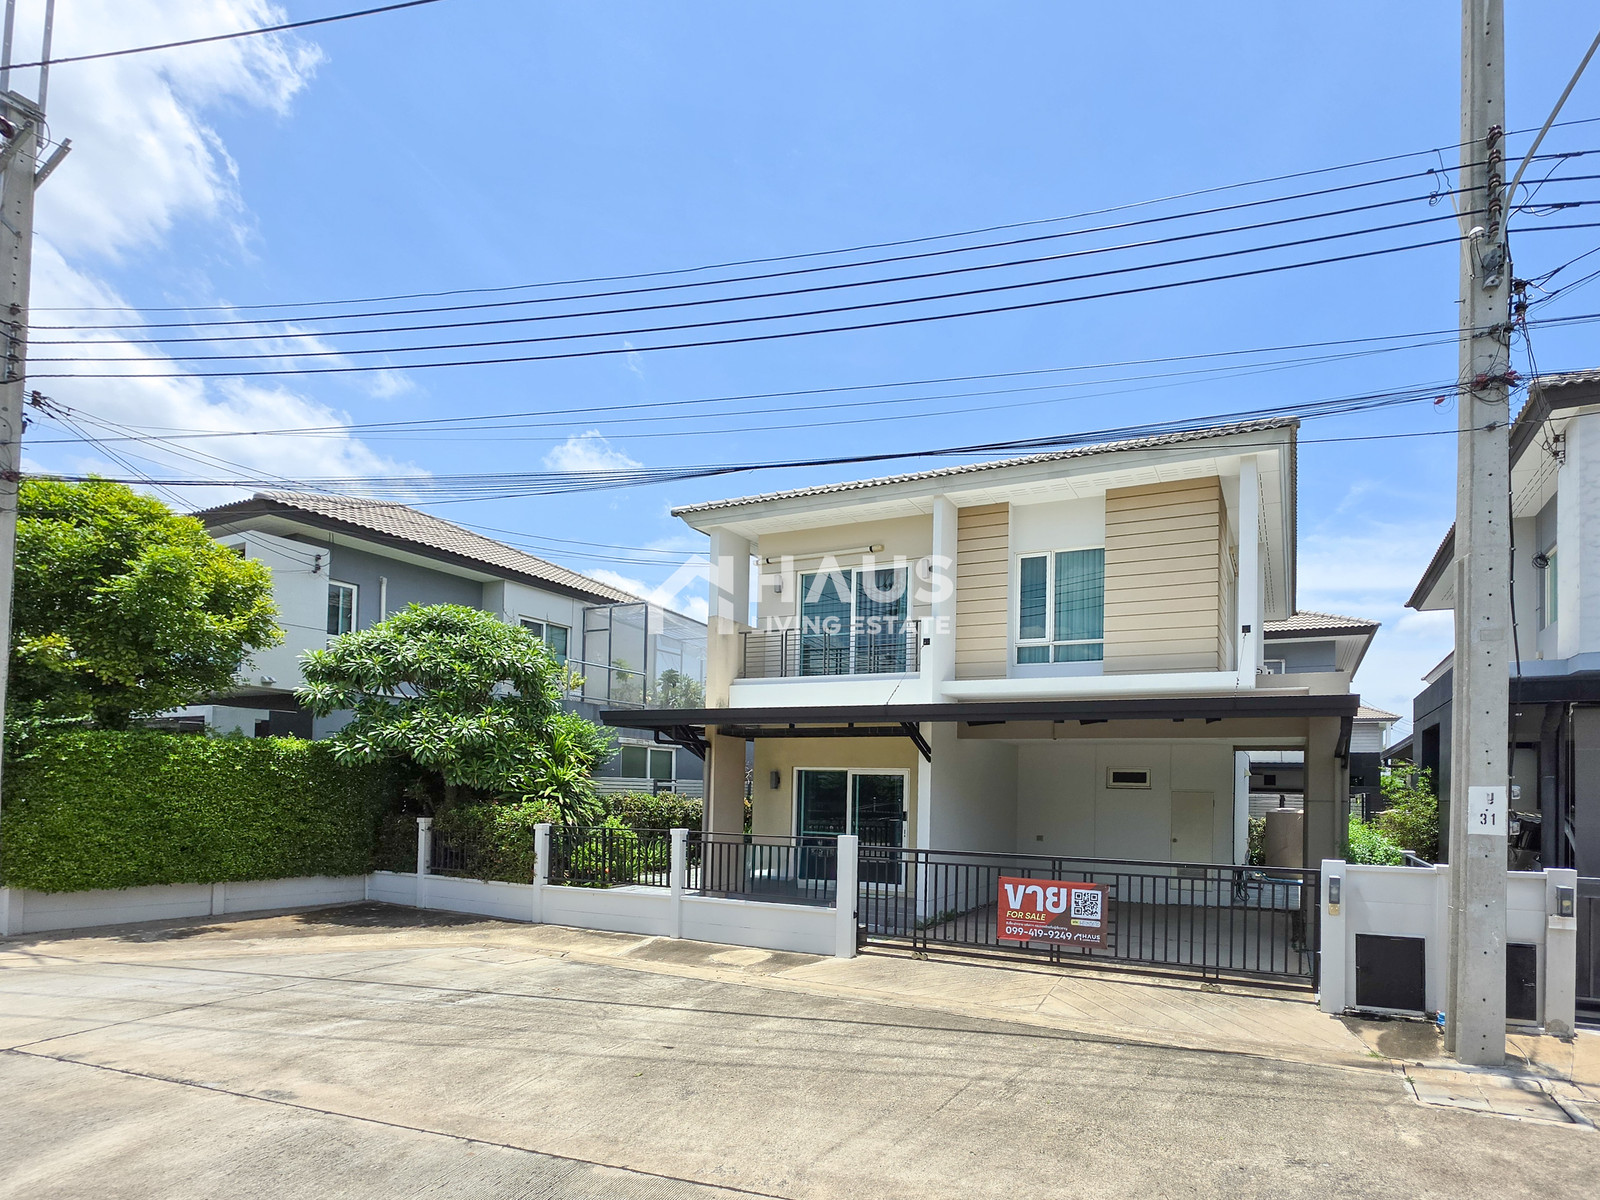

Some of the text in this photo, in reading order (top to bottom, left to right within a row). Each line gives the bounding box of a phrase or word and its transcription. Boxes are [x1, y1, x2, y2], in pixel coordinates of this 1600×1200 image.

[1480, 813, 1496, 826] 31
[1004, 884, 1068, 914] ขาย
[1006, 910, 1046, 921] FOR SALE
[1005, 925, 1072, 940] 099-419-9249
